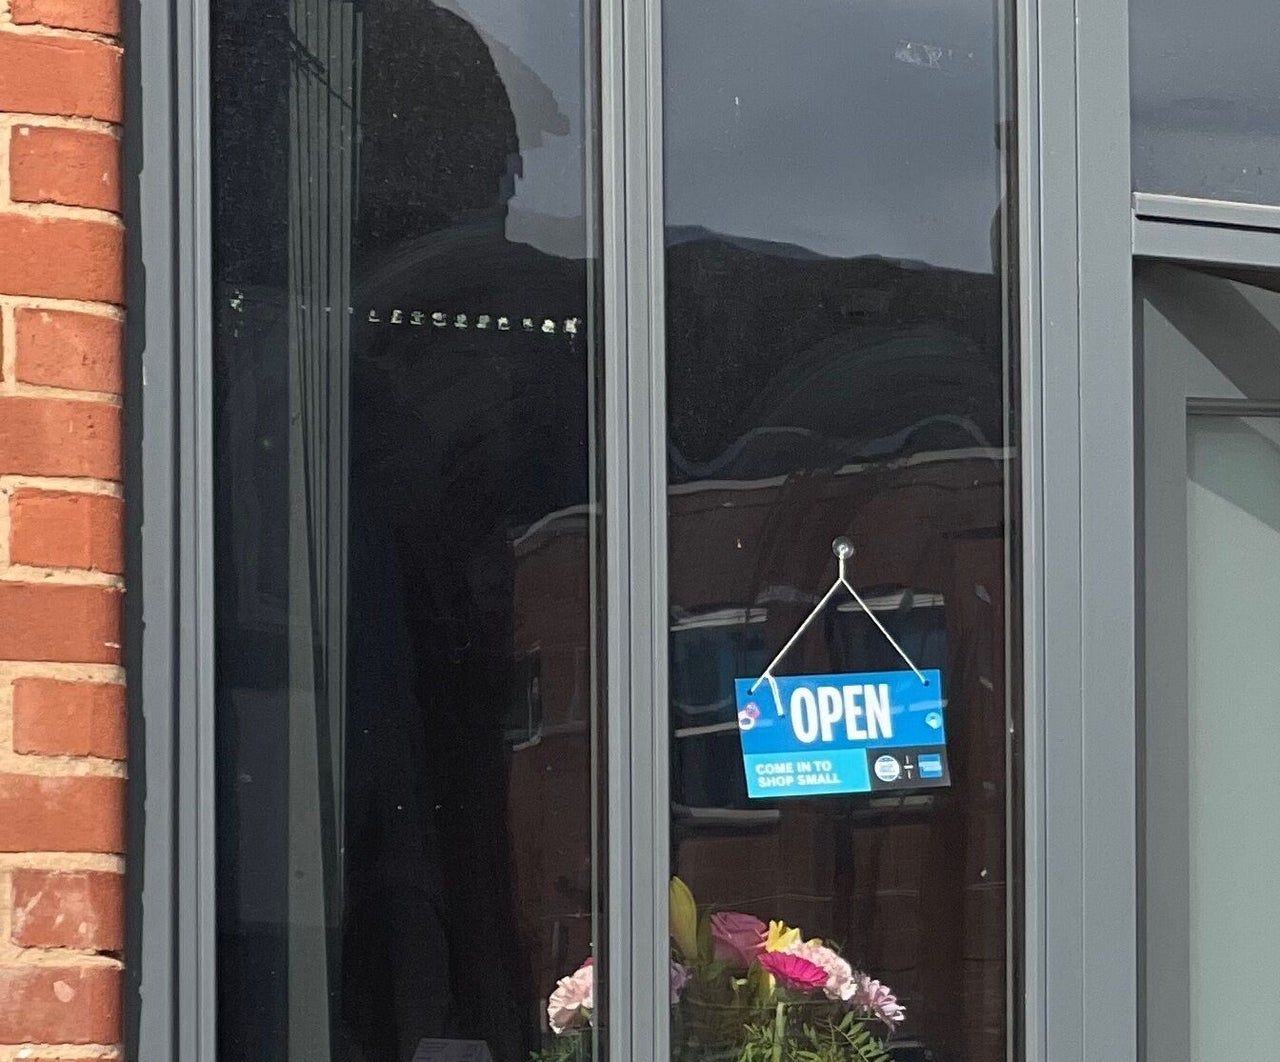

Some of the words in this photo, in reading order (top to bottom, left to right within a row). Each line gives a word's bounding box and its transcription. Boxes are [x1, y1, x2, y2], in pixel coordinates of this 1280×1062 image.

[789, 683, 894, 744] OPEN
[755, 762, 795, 775] COME
[797, 761, 811, 773] IN
[813, 760, 832, 772] TO
[757, 776, 795, 788] SHOP
[797, 772, 841, 786] SMALL
